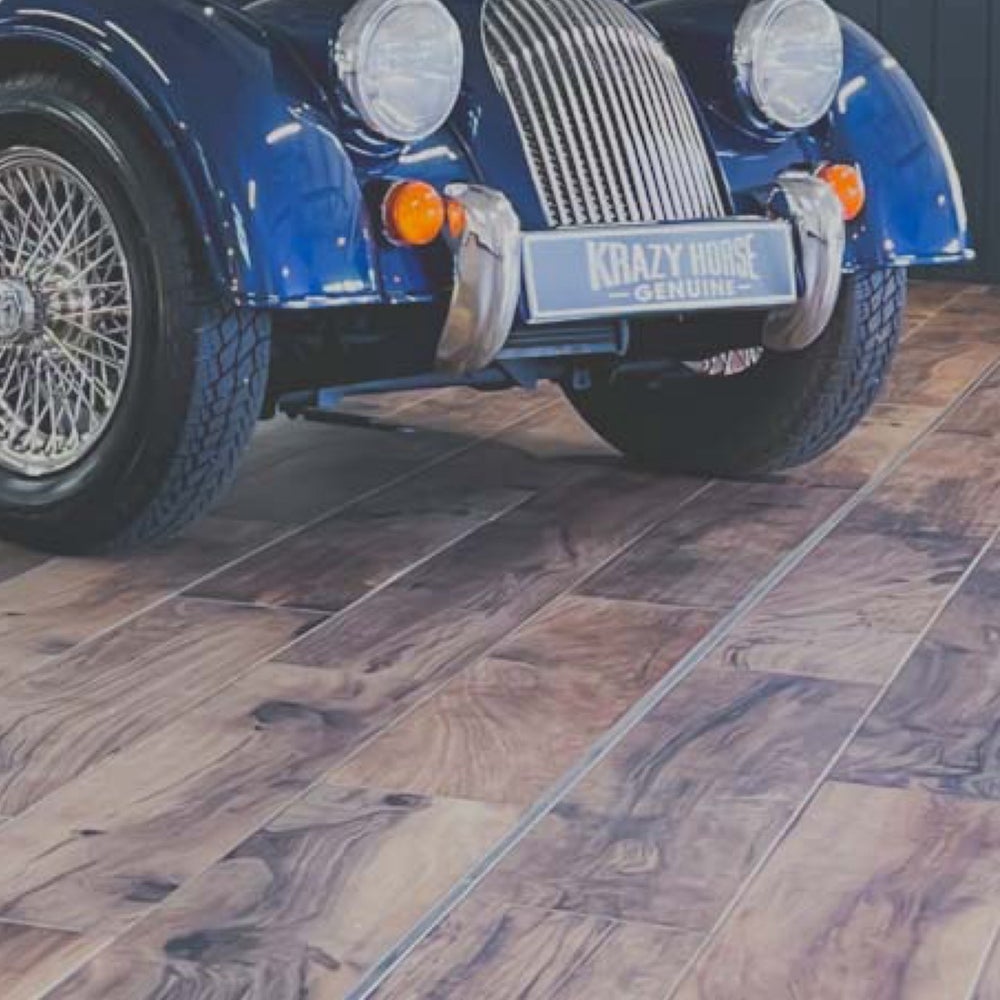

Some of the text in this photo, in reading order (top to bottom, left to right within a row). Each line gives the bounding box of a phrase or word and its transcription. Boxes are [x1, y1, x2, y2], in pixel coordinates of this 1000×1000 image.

[587, 233, 760, 291] KRAZY HORSE
[636, 280, 736, 302] GENUINE
